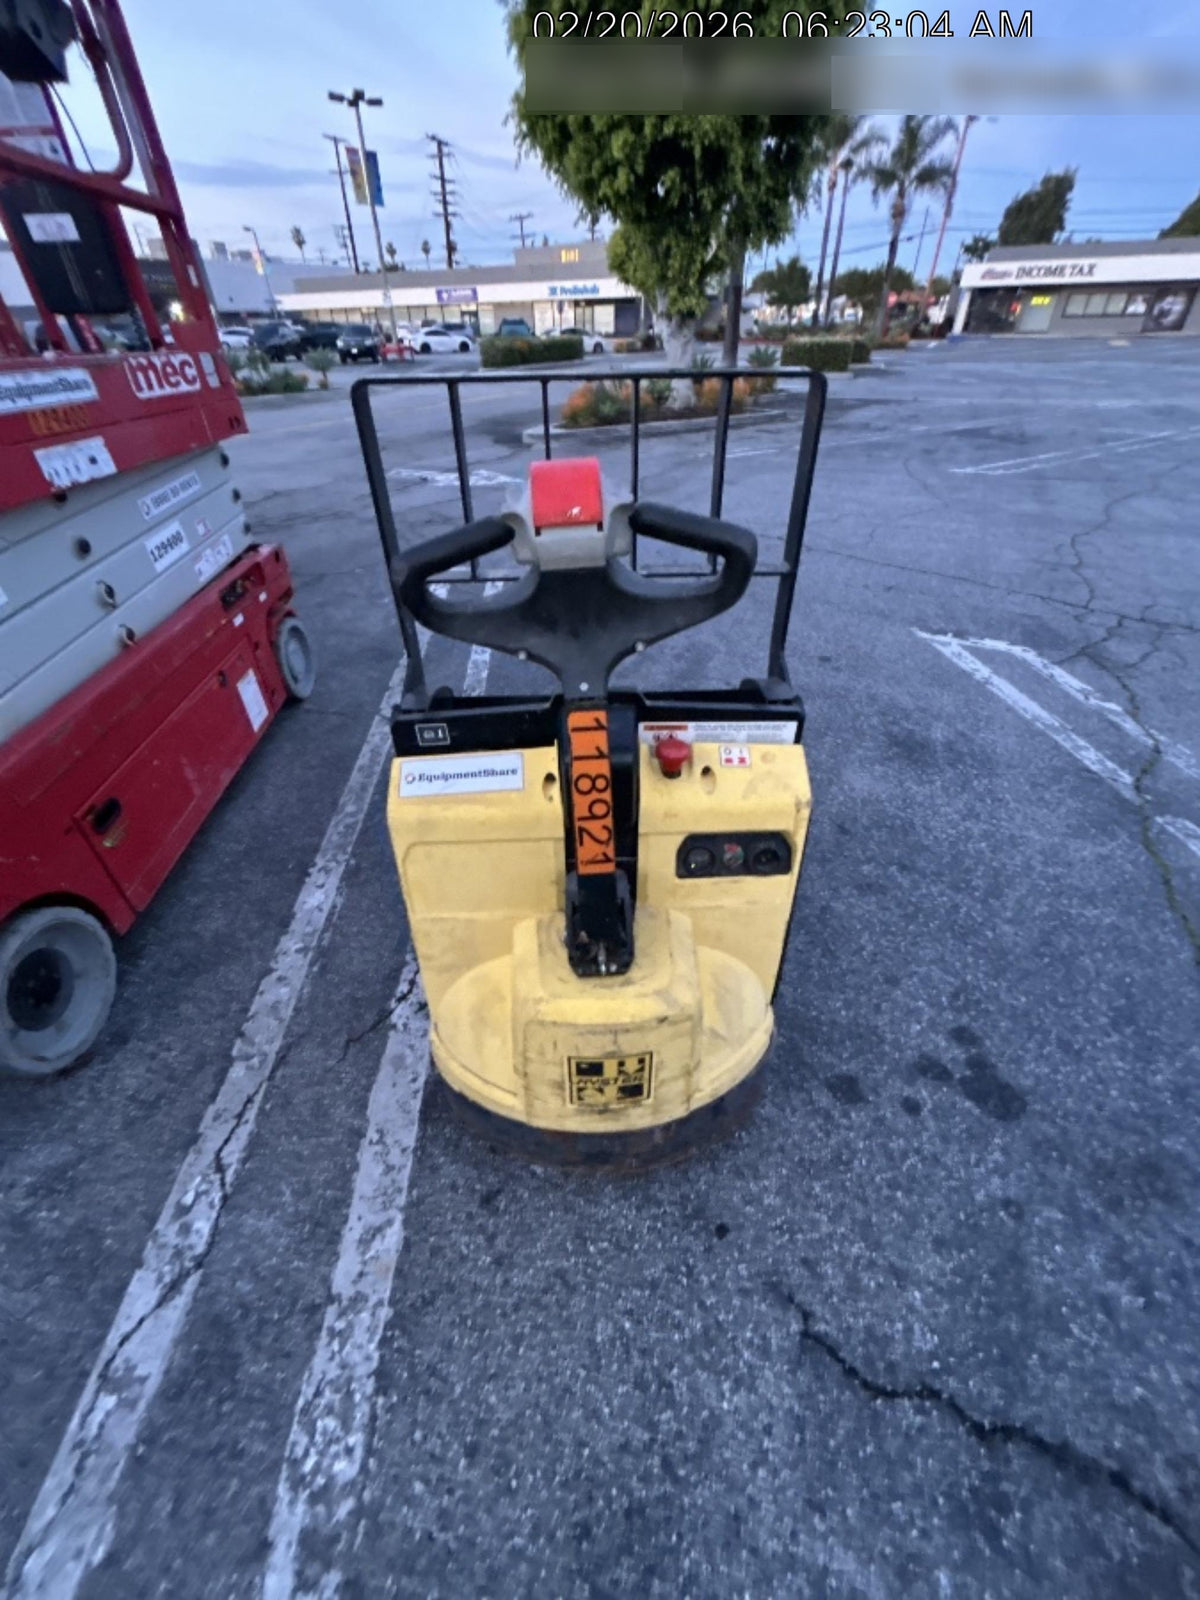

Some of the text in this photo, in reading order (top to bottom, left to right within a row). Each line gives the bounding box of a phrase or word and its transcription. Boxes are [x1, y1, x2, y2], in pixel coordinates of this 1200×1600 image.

[1015, 265, 1067, 280] INCOME
[1069, 263, 1097, 277] TAX
[418, 767, 519, 783] EquipmentShare
[570, 716, 615, 868] 118921
